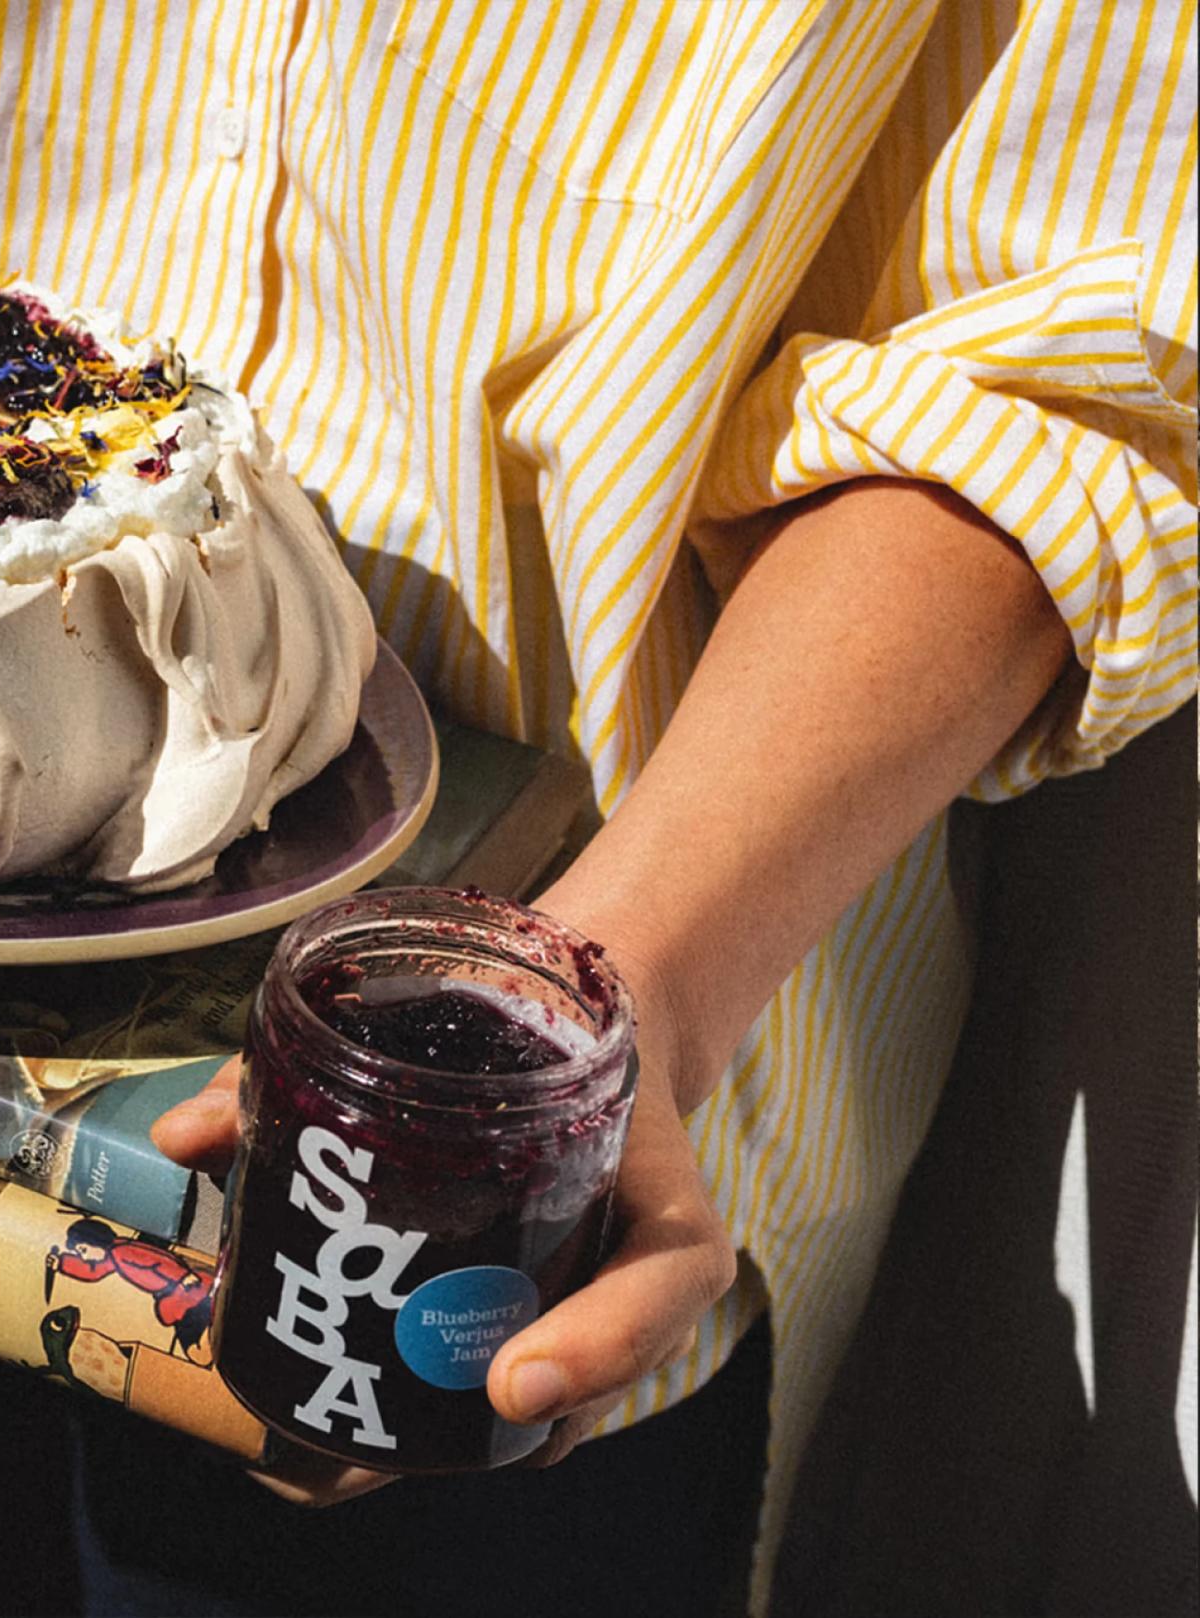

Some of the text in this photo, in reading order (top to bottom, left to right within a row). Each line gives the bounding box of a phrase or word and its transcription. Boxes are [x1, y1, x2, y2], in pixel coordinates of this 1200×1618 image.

[87, 1151, 110, 1203] Potter
[421, 1302, 523, 1326] Blueberry
[440, 1325, 505, 1344] Verjus
[450, 1346, 491, 1362] Jam
